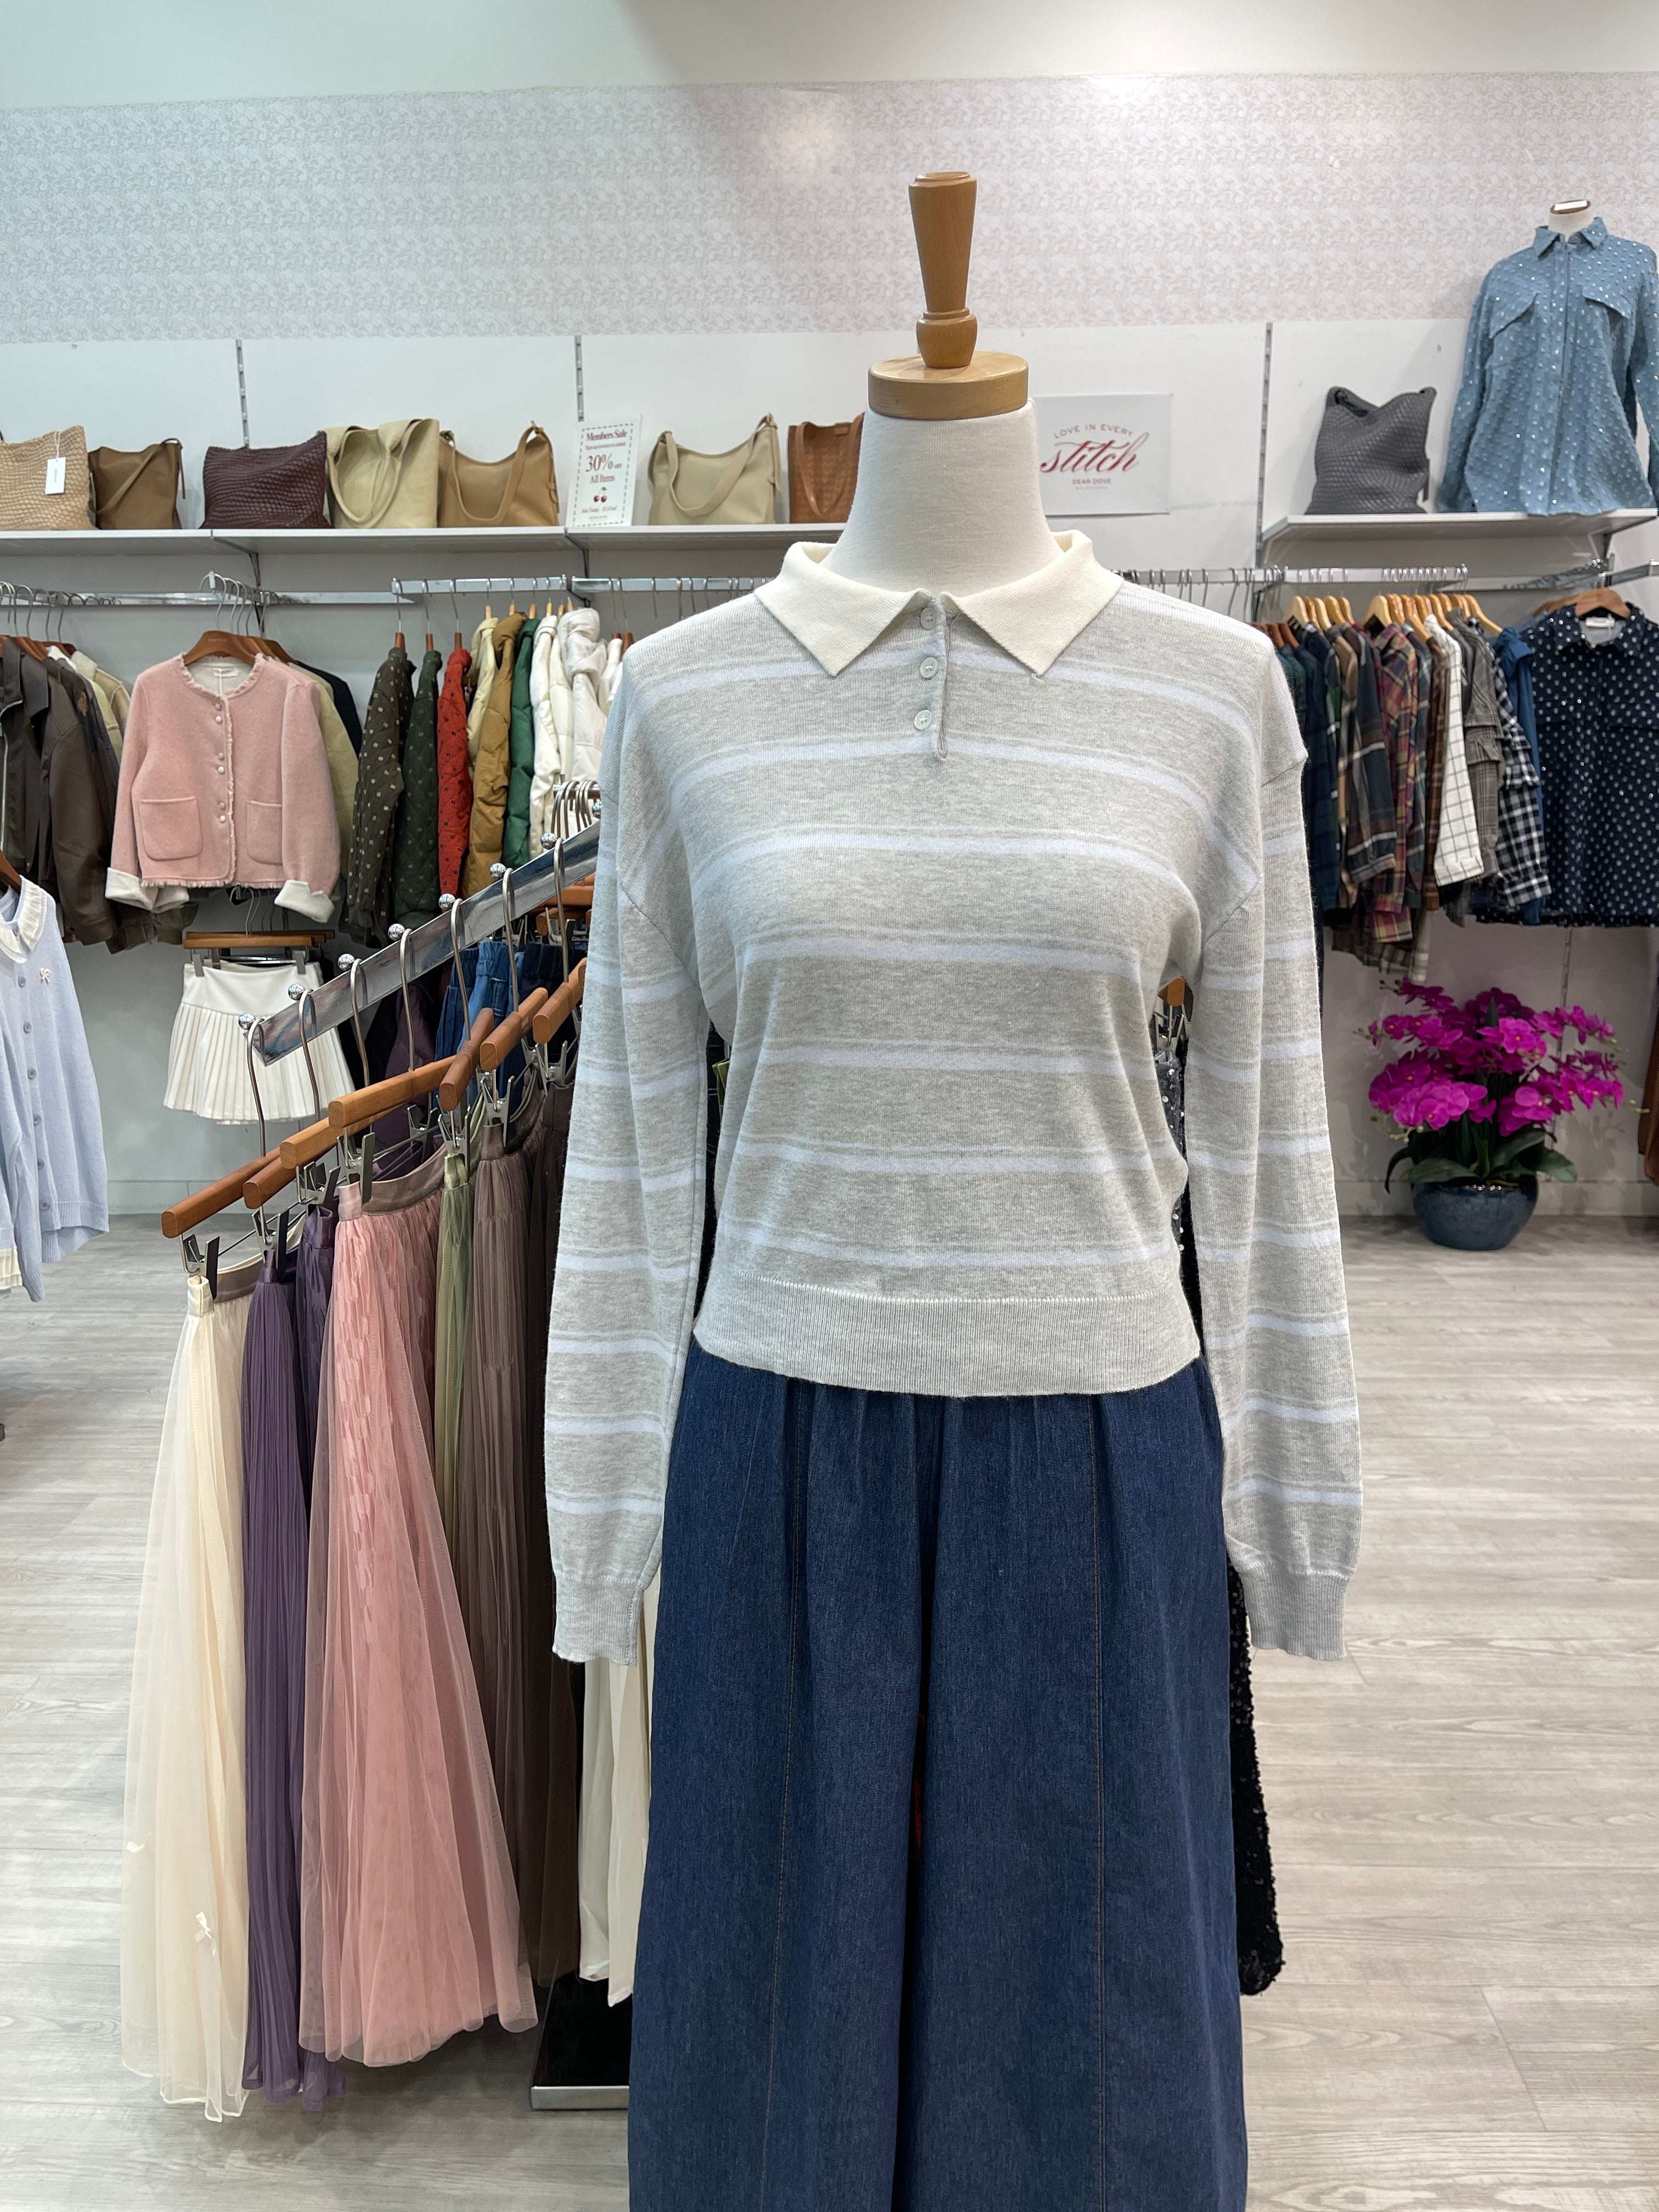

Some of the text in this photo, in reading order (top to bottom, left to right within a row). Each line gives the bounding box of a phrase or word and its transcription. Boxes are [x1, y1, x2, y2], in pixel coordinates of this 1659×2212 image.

[614, 429, 628, 438] Sale
[1054, 425, 1080, 438] LOVE
[1101, 424, 1133, 437] EVERY
[585, 453, 613, 472] 30%
[590, 474, 616, 483] All Items
